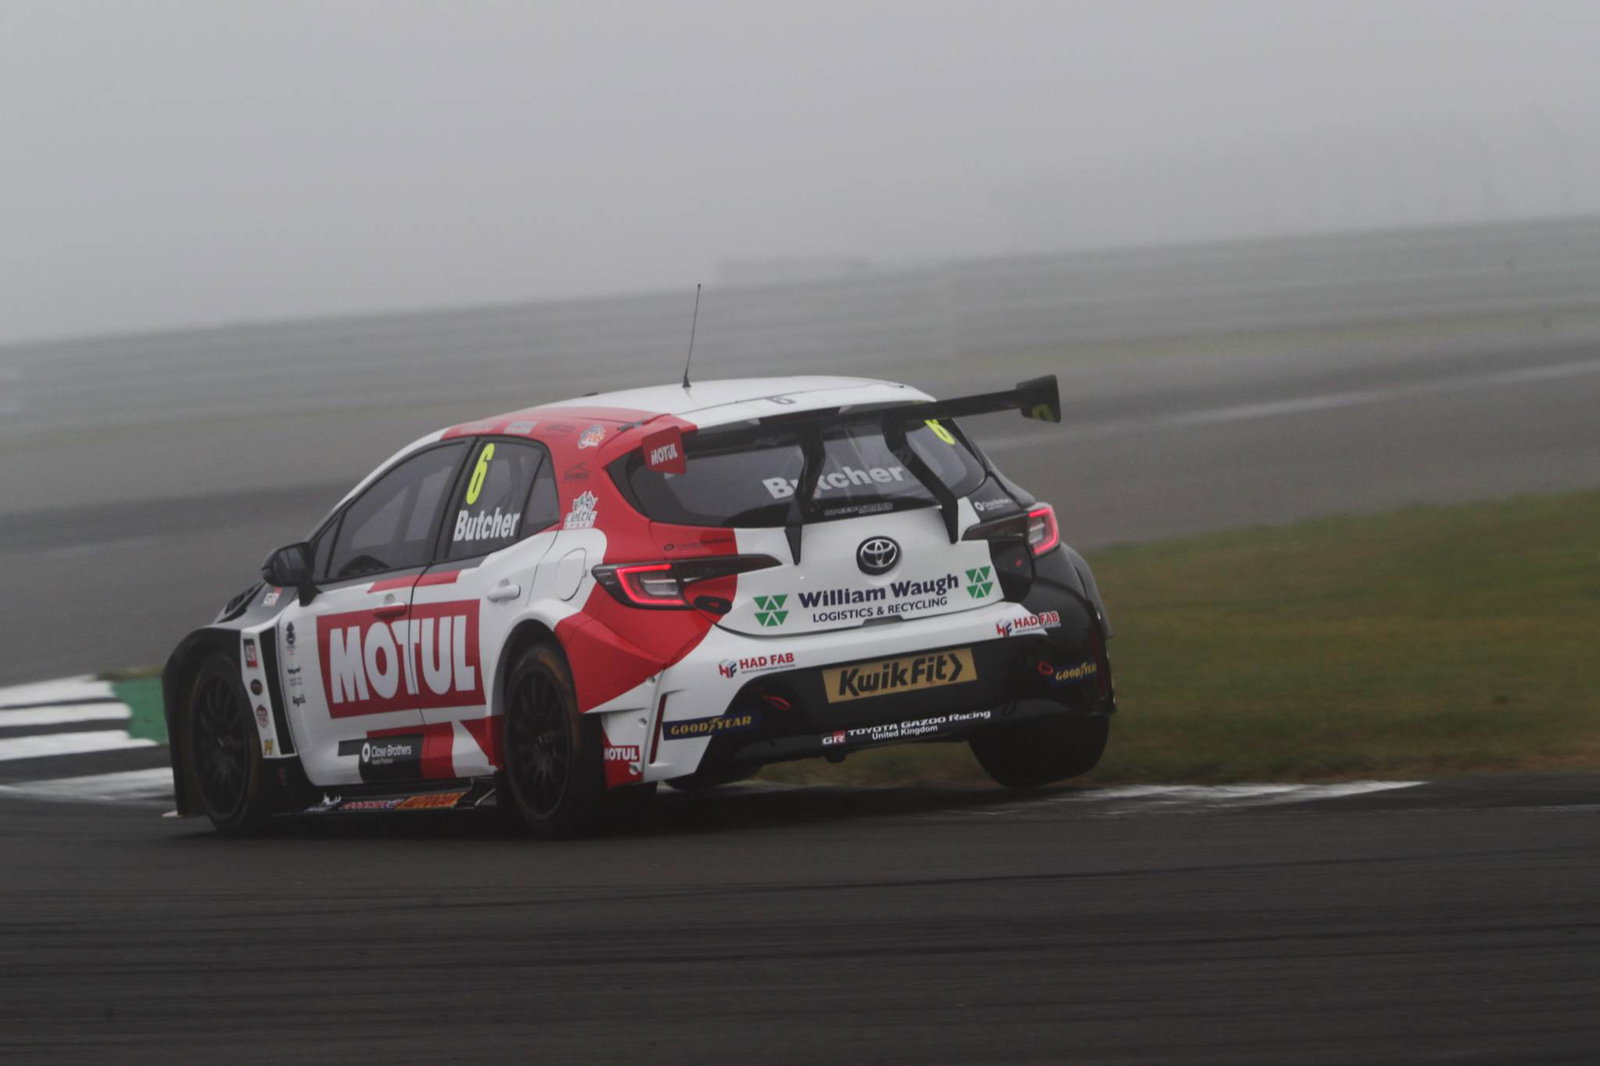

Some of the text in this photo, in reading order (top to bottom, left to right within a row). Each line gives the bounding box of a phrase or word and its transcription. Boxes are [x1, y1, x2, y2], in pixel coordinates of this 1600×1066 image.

[650, 442, 678, 466] MOTUL
[466, 443, 495, 505] 6
[762, 465, 905, 500] Btcher
[453, 507, 521, 542] Butcher
[798, 573, 960, 609] William Waugh
[813, 596, 948, 623] LOGISTICS & RECYCLING
[1013, 614, 1039, 629] HAD
[1039, 610, 1060, 625] FAB
[329, 615, 476, 705] MOTUL
[739, 656, 768, 670] HAD
[770, 652, 795, 666] FAB
[670, 714, 752, 735] GOODYEAR
[822, 710, 991, 746] GR TOYOTA GAZOO Racing
[872, 724, 938, 741] United Kingdom
